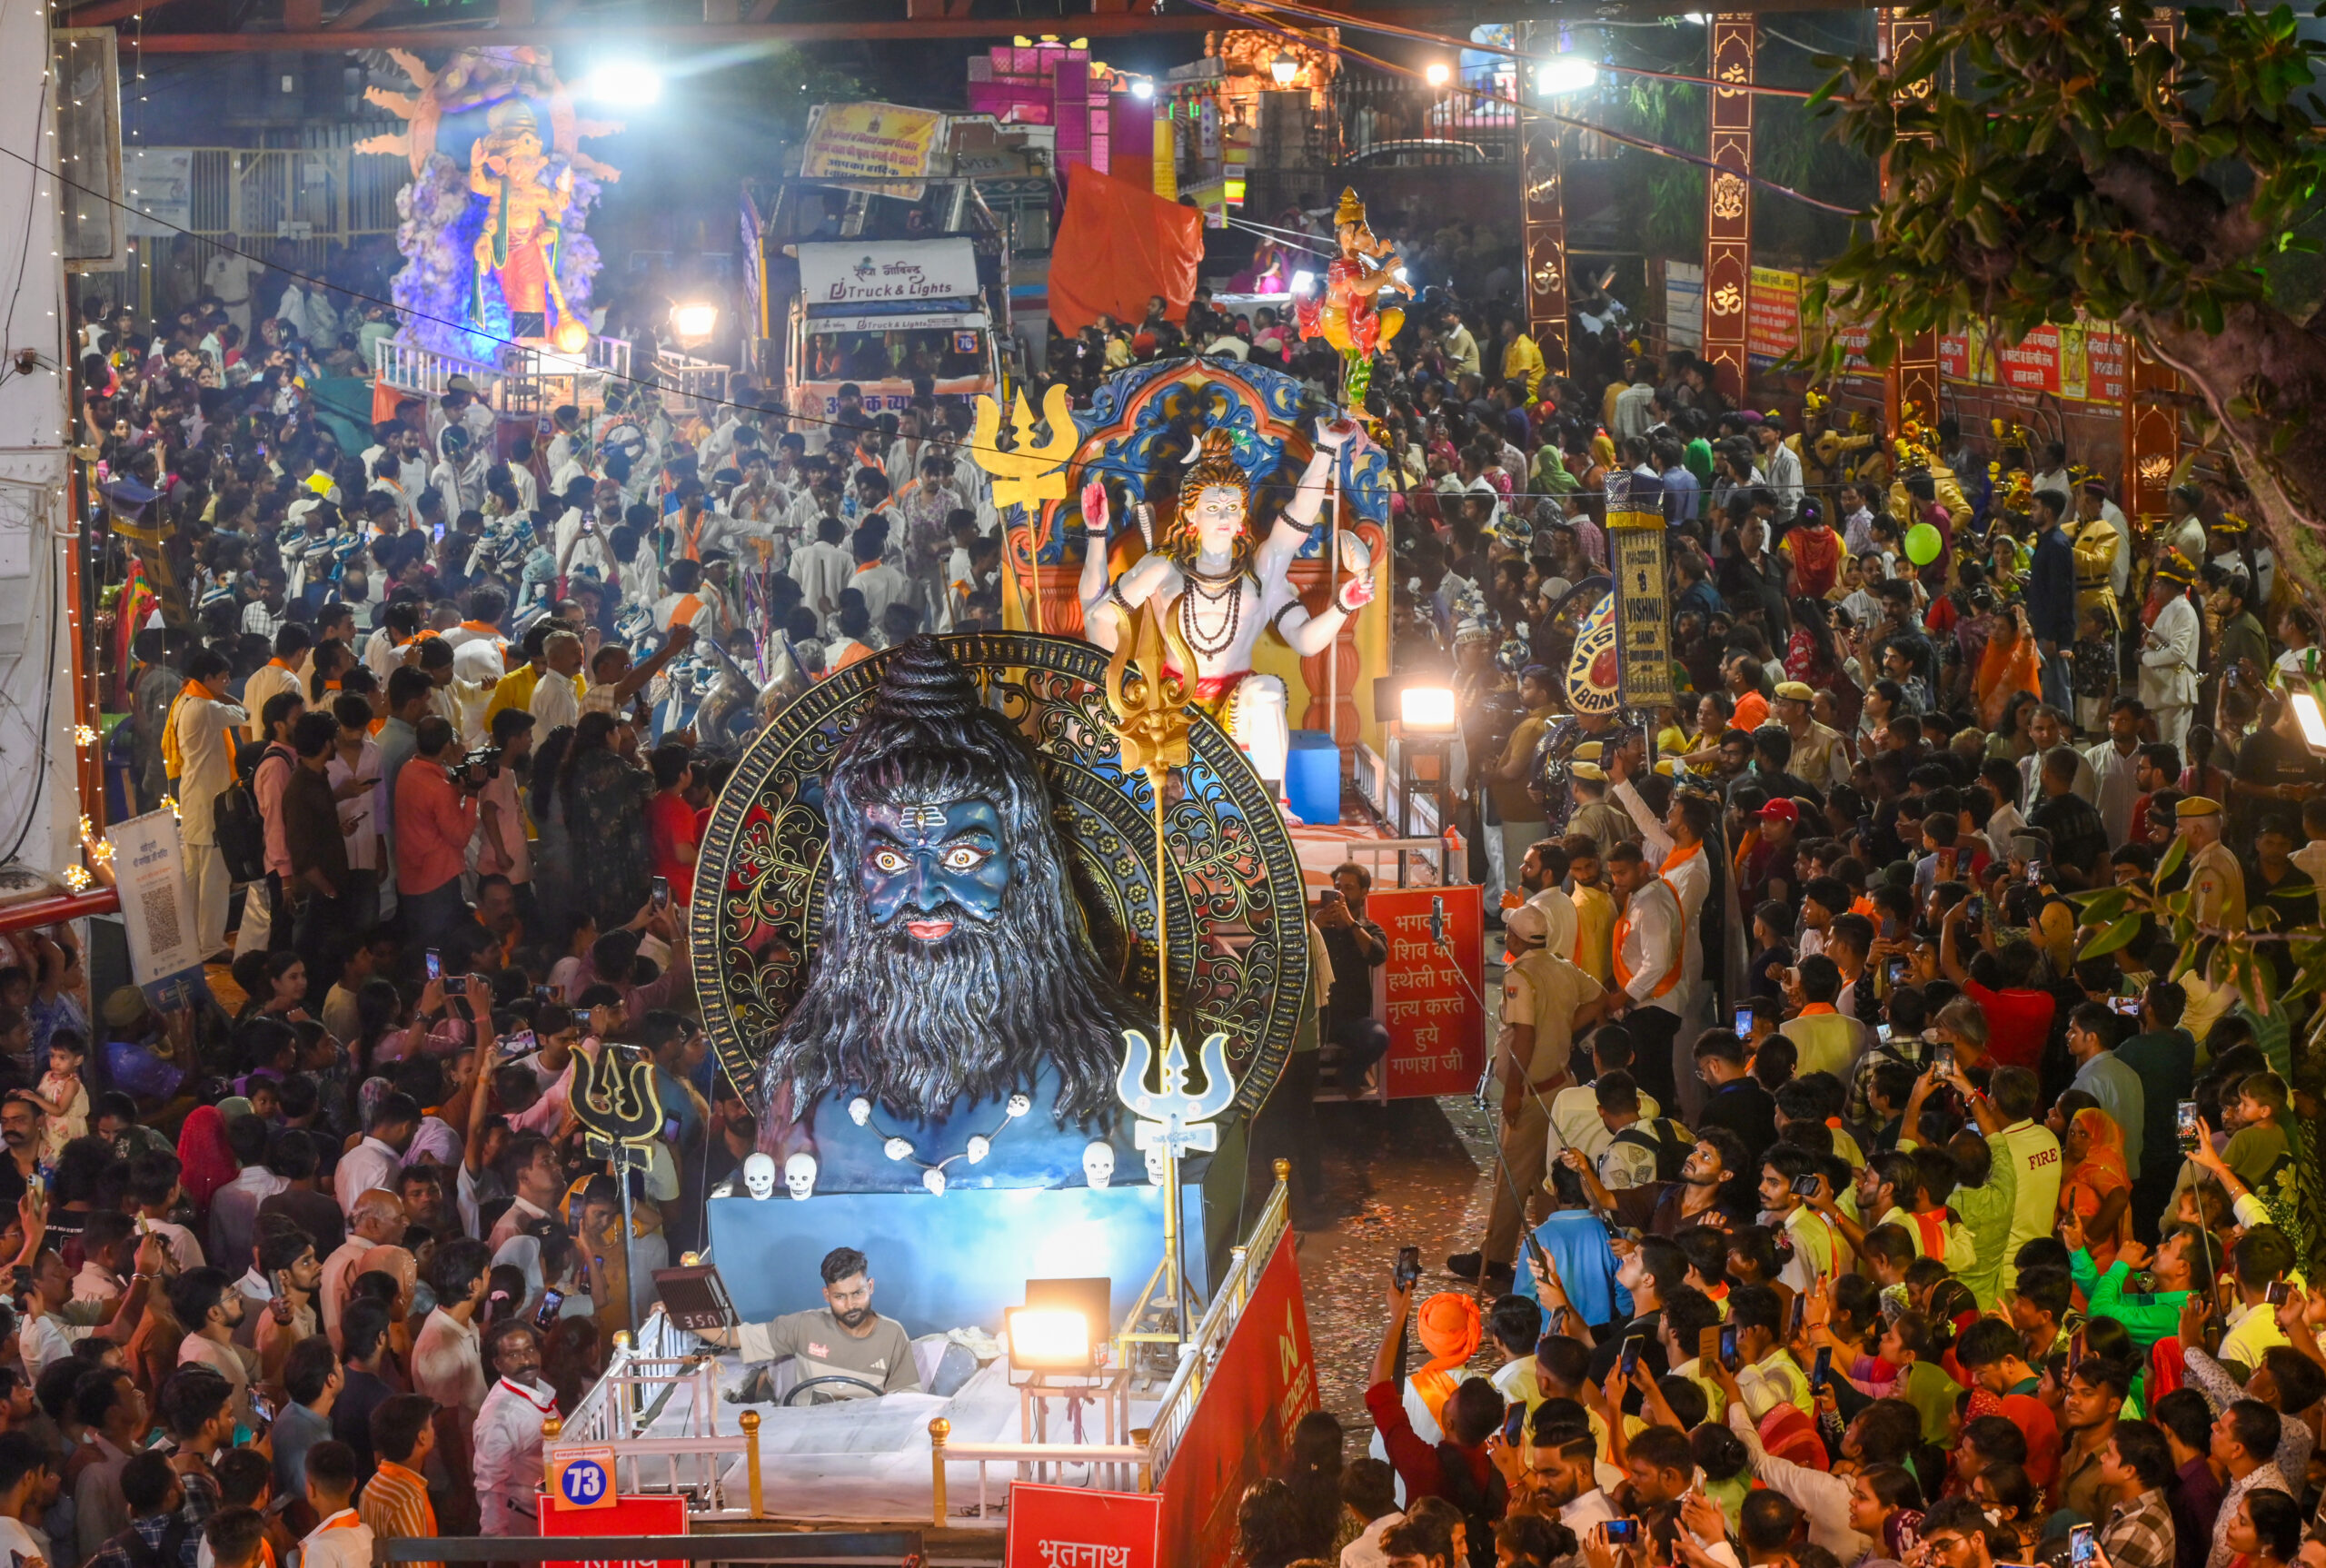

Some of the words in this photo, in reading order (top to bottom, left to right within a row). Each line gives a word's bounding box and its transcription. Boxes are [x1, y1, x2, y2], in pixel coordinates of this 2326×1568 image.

[827, 159, 864, 171] आपका
[848, 283, 893, 299] Truck
[895, 284, 904, 296] &
[909, 283, 952, 297] Lights
[868, 321, 892, 330] Truck
[902, 320, 927, 330] Lights
[958, 337, 972, 349] 76
[1626, 597, 1662, 623] VISHNU
[1635, 630, 1655, 645] BAND
[1393, 938, 1428, 961] शिव
[1387, 965, 1436, 992] हथेली
[1439, 968, 1464, 987] पर
[1386, 1001, 1420, 1025] नृत्य
[1424, 991, 1465, 1017] करते
[1413, 1021, 1439, 1052] हुये
[1440, 1047, 1464, 1071] जी
[2028, 1147, 2058, 1171] FIRE
[1279, 1362, 1310, 1428] WONDER
[567, 1466, 601, 1497] 73
